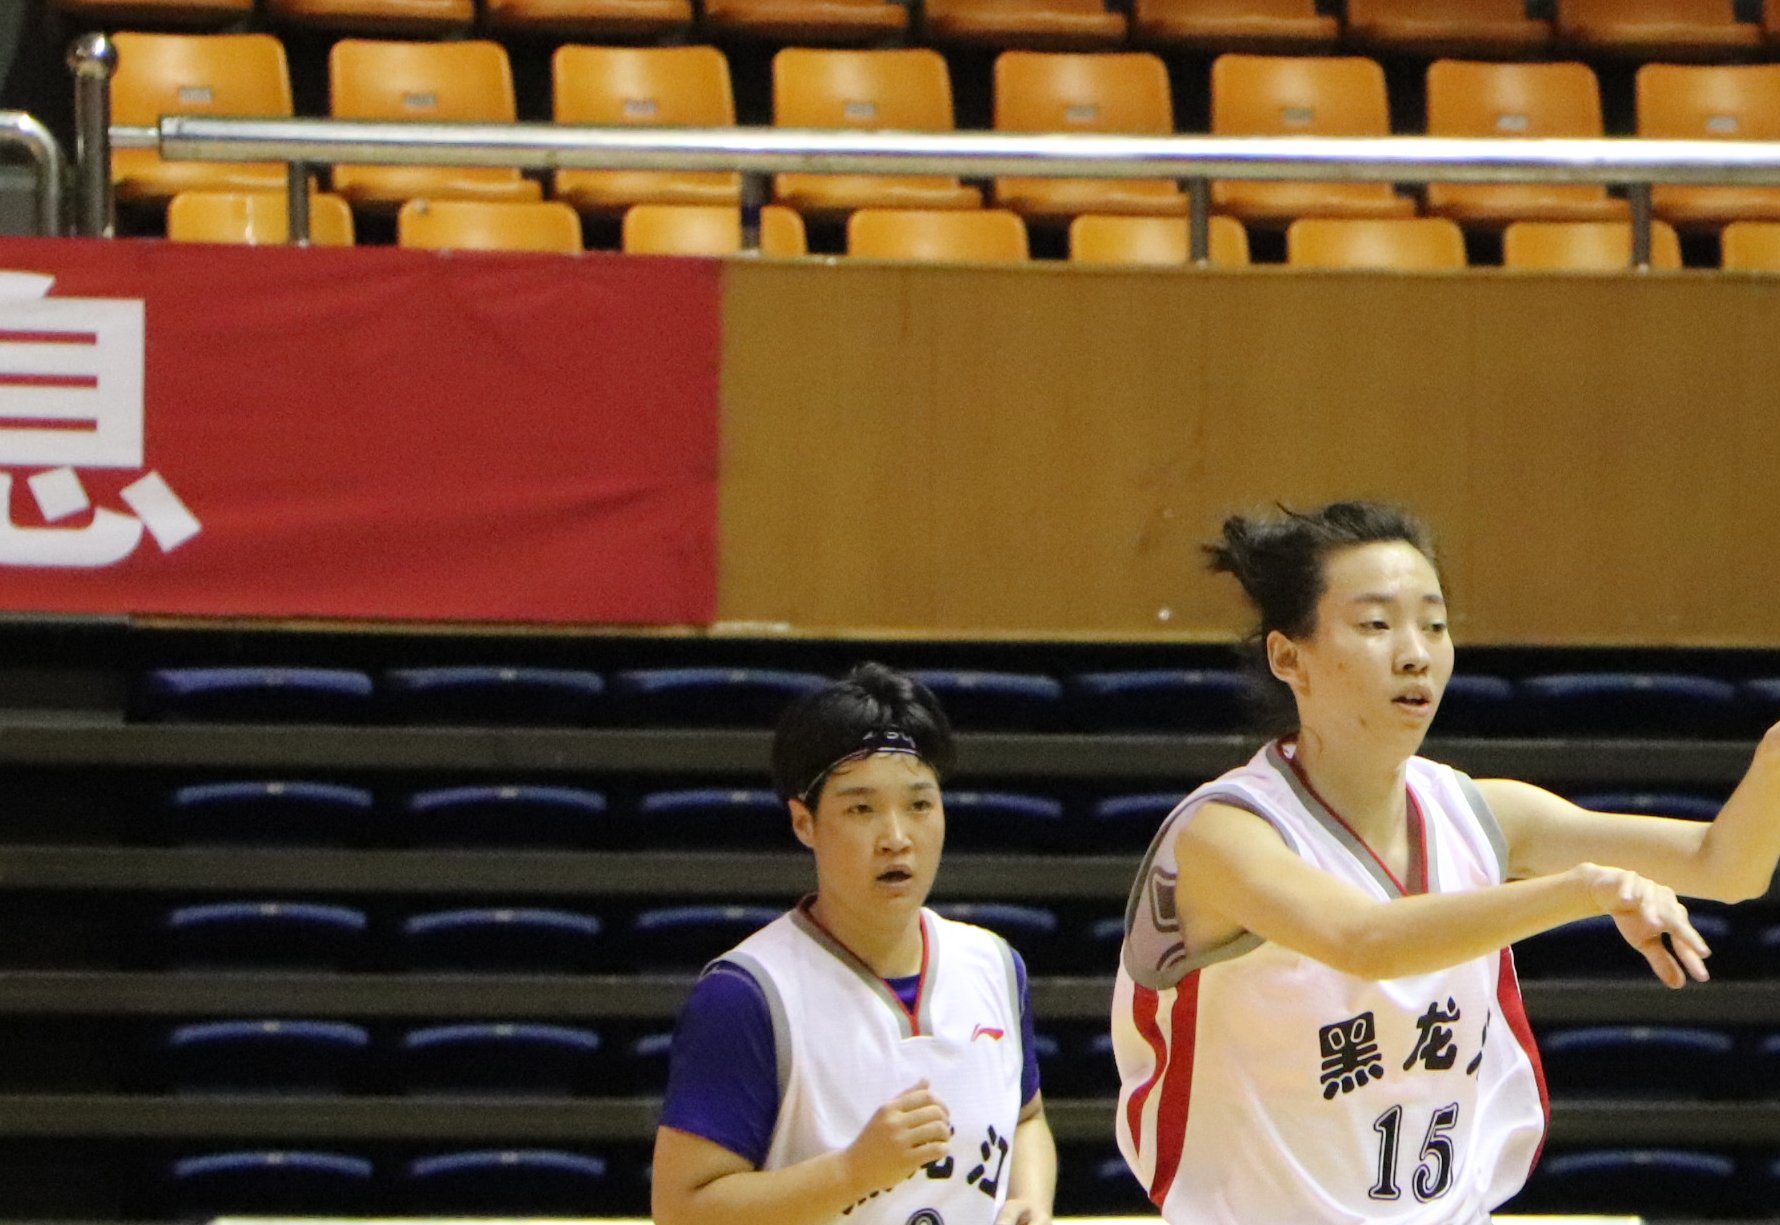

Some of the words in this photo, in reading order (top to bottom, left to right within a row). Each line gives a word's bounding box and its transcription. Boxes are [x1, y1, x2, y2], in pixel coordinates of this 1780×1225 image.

[0, 269, 202, 567] 息
[1318, 996, 1491, 1100] 黑龙
[1368, 1102, 1460, 1204] 15
